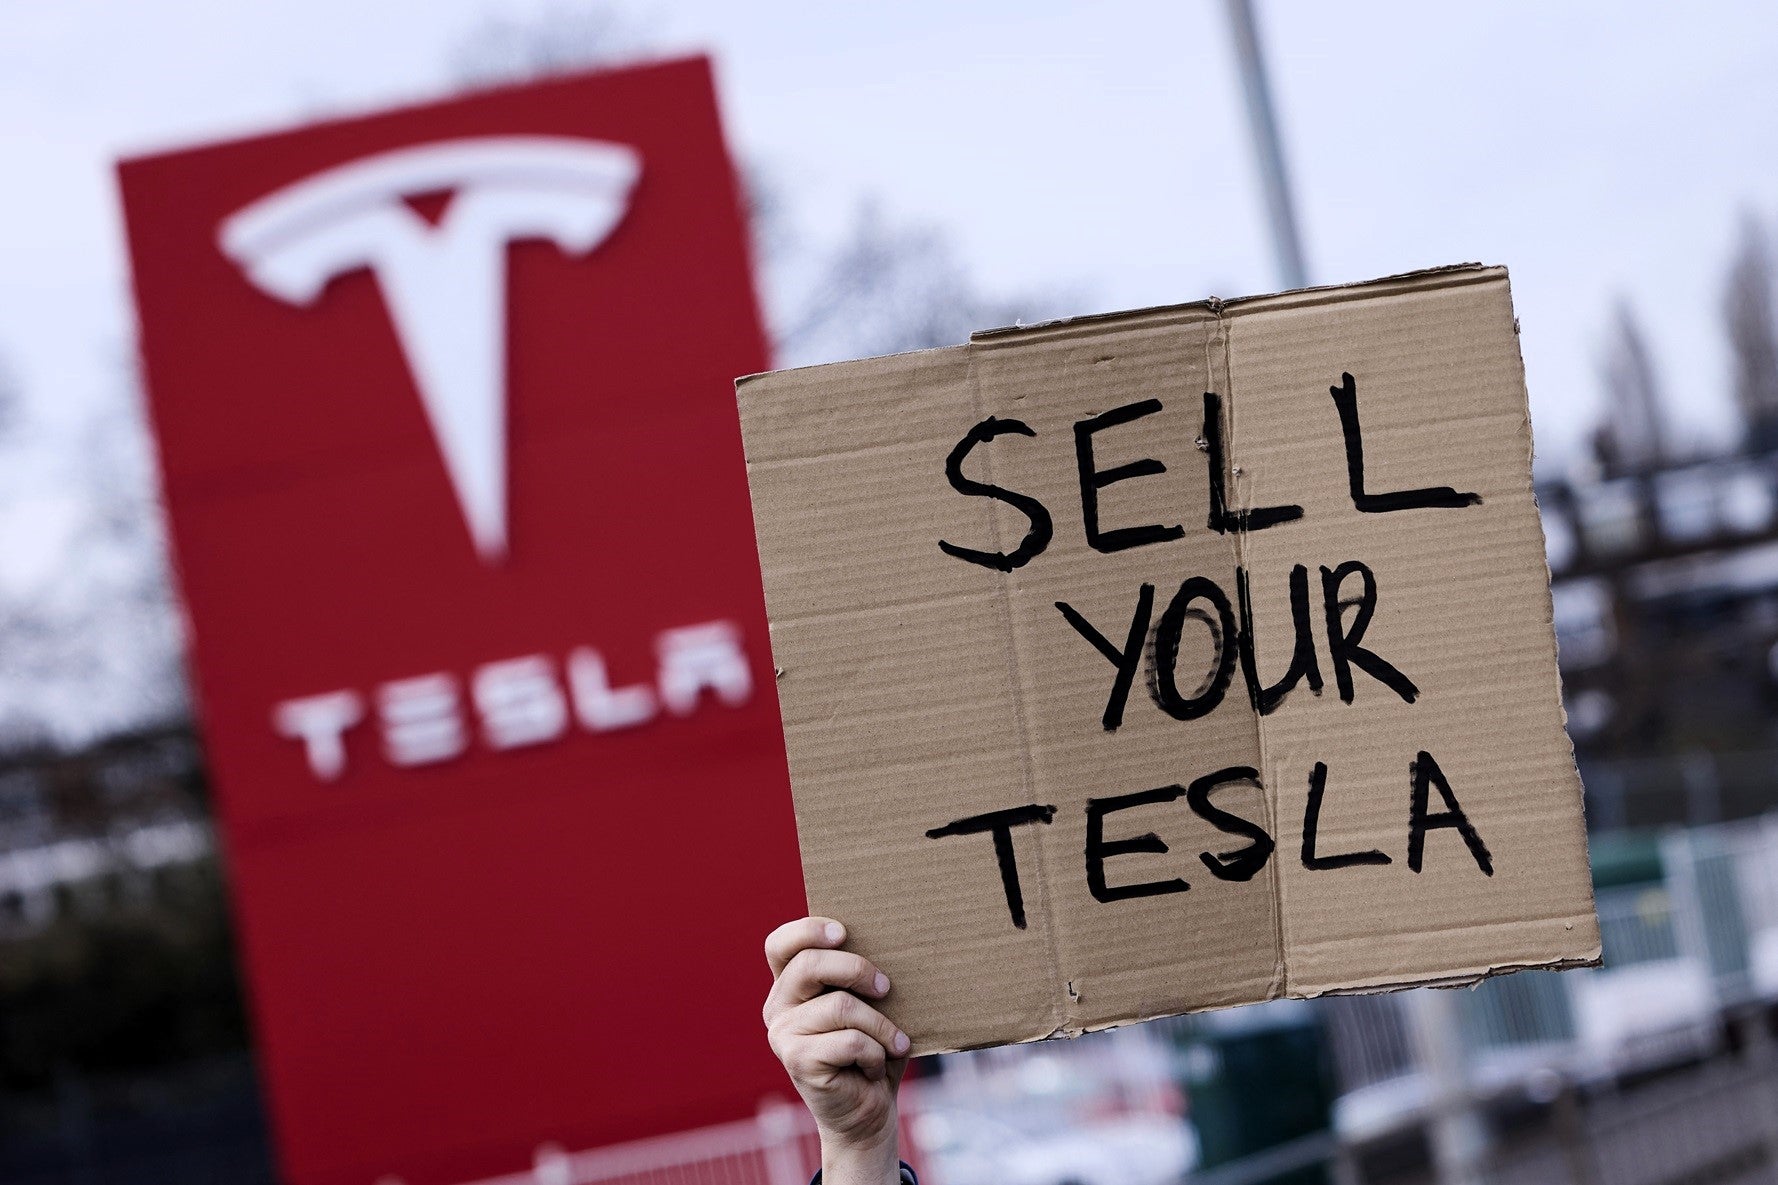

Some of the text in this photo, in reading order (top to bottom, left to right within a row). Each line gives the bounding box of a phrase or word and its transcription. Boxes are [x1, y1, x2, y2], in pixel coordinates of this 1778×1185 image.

[938, 371, 1484, 573] SELL
[273, 619, 754, 781] TESLA
[1055, 560, 1420, 733] YOUR
[925, 750, 1494, 930] TESLA
